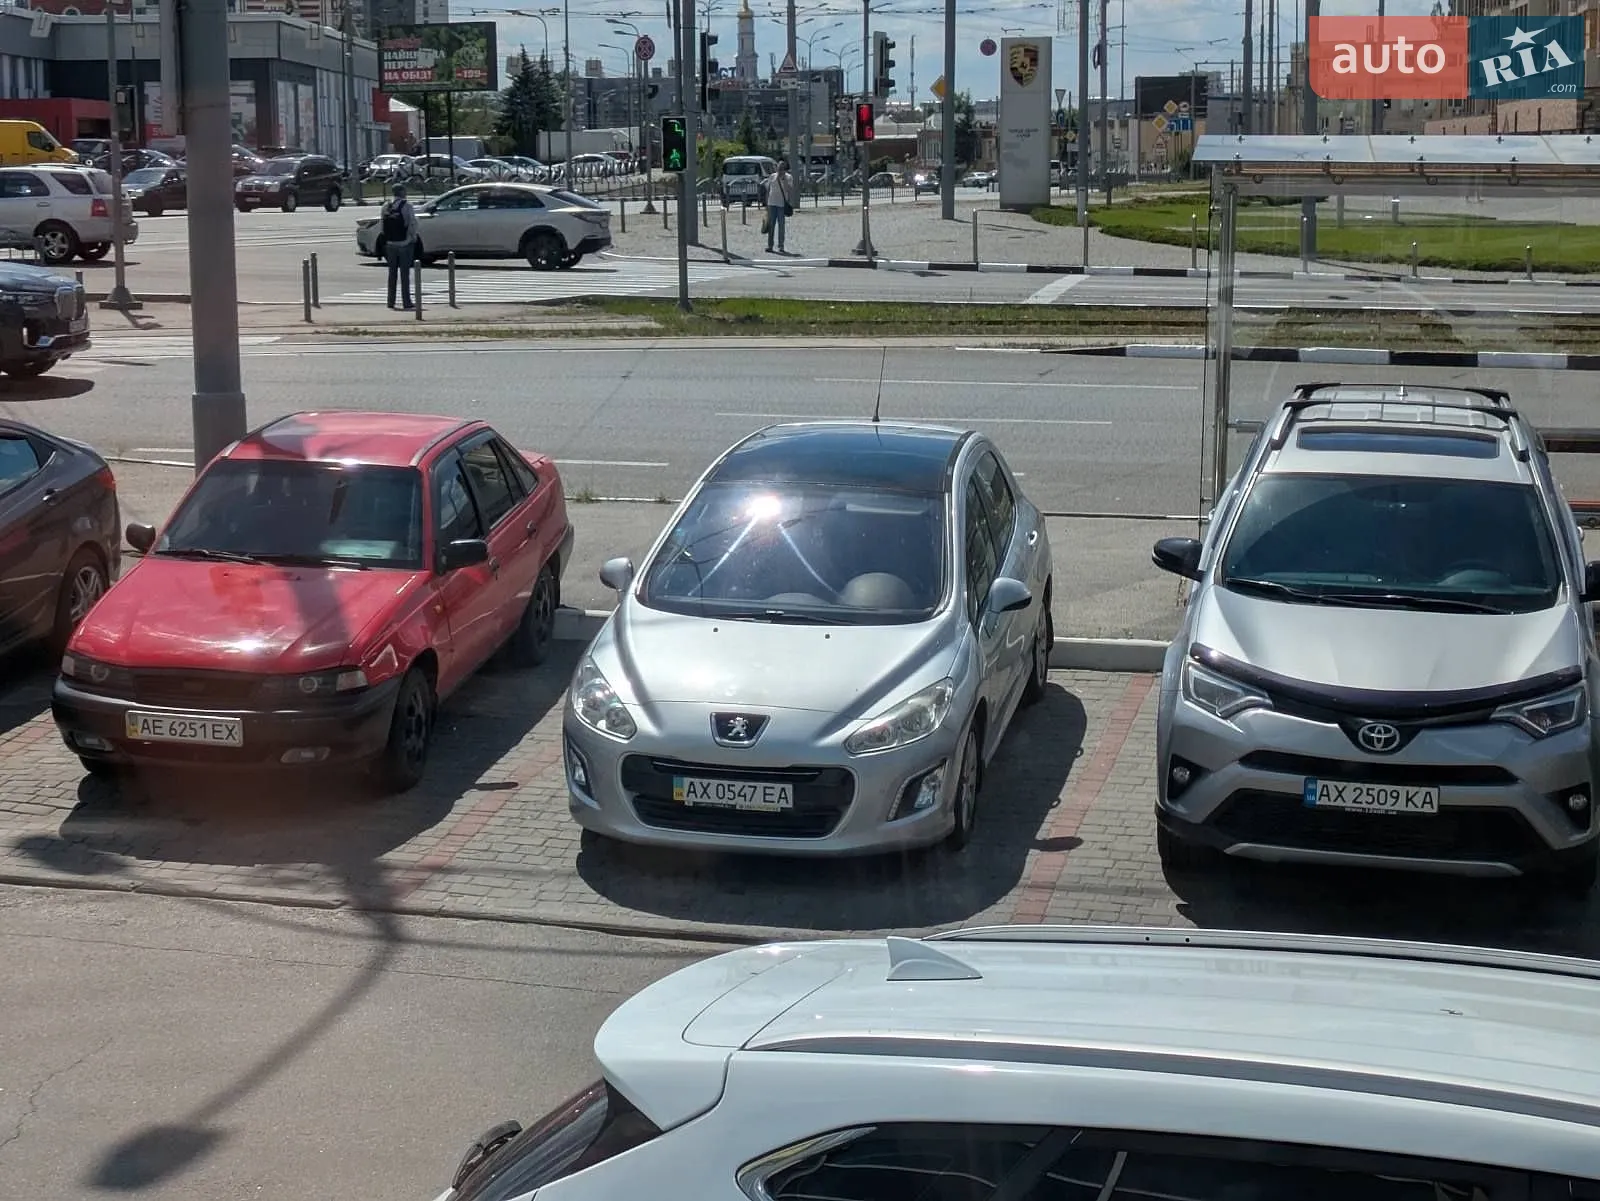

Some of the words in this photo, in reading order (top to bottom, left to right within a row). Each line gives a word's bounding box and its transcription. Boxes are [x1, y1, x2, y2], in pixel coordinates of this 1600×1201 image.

[140, 718, 165, 736] AE
[168, 721, 207, 739] 6251
[211, 723, 236, 741] EX
[686, 780, 711, 799] AX
[715, 783, 758, 802] 0547
[763, 786, 789, 804] EA
[1318, 784, 1347, 803] AX
[1352, 786, 1400, 807] 2509
[1405, 790, 1434, 810] KA
